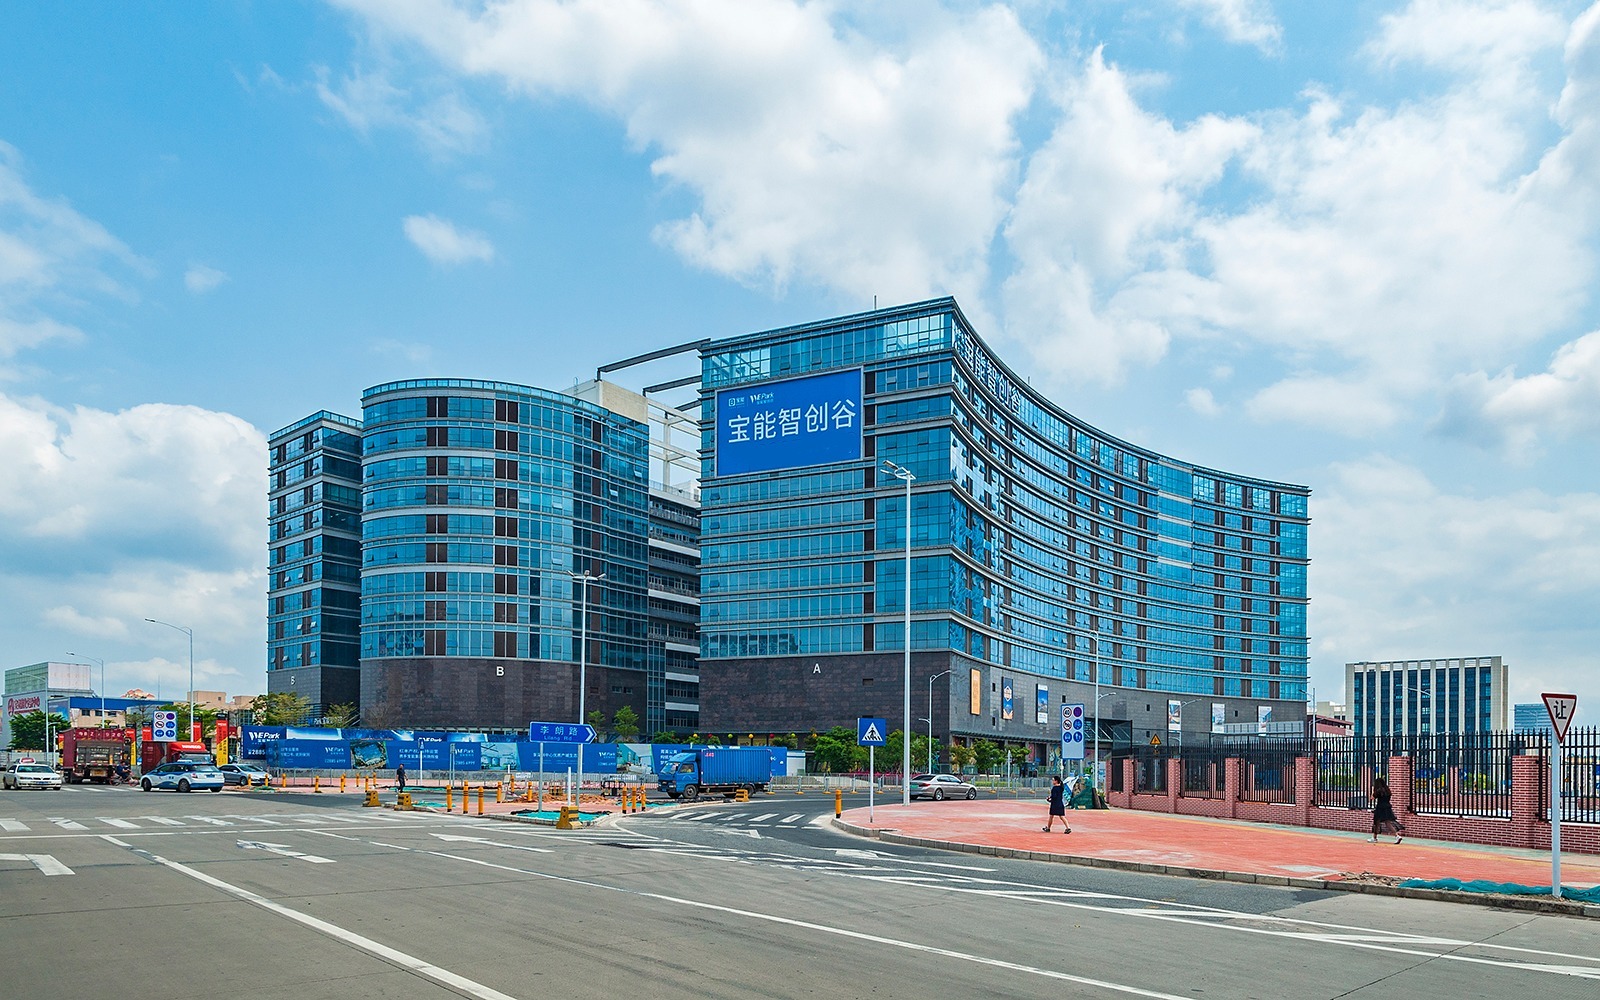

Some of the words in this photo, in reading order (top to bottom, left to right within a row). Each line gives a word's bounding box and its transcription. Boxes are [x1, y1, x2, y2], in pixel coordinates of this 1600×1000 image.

[728, 398, 856, 444] 宝能智创谷
[496, 665, 505, 677] B
[812, 663, 821, 674] A
[1553, 700, 1567, 720] 让
[540, 725, 578, 736] 李朗路
